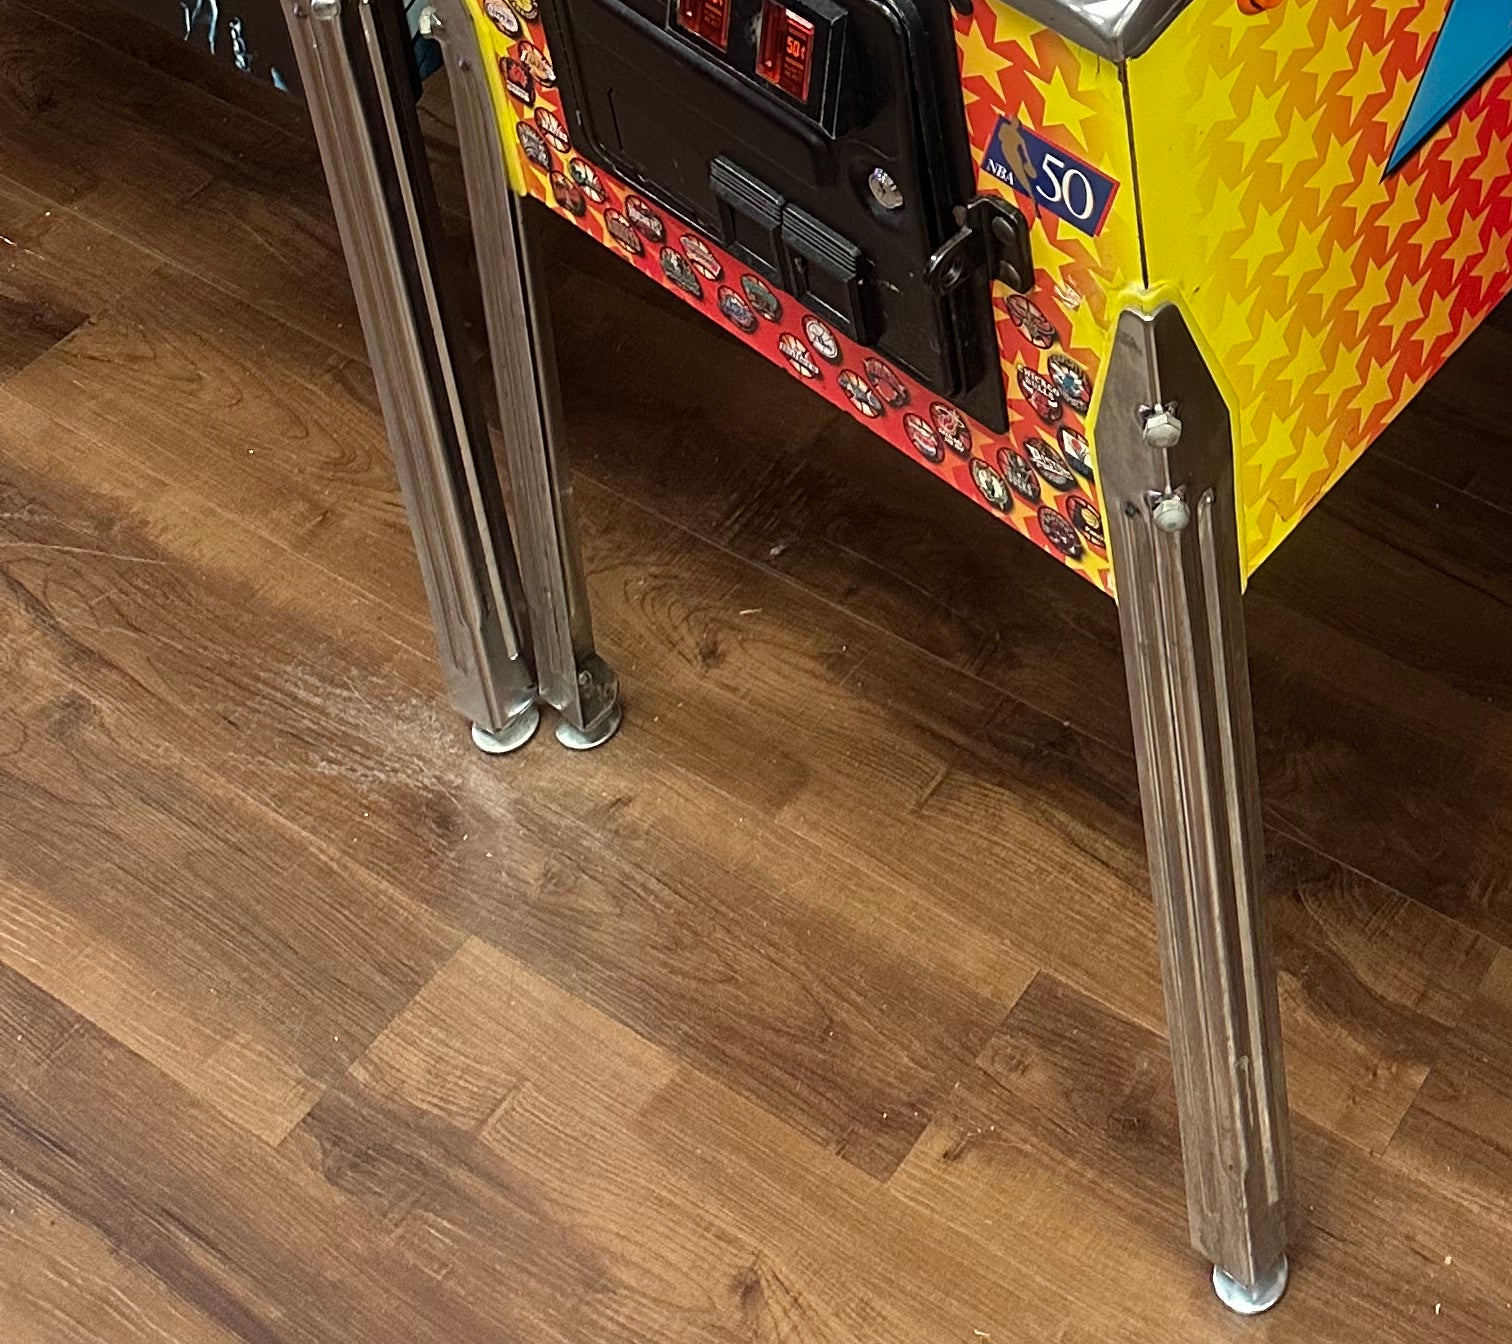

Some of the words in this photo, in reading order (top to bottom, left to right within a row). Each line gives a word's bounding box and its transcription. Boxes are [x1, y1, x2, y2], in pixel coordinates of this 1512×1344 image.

[786, 36, 806, 61] 50¢
[986, 158, 1015, 187] NBA
[1036, 152, 1095, 222] 50
